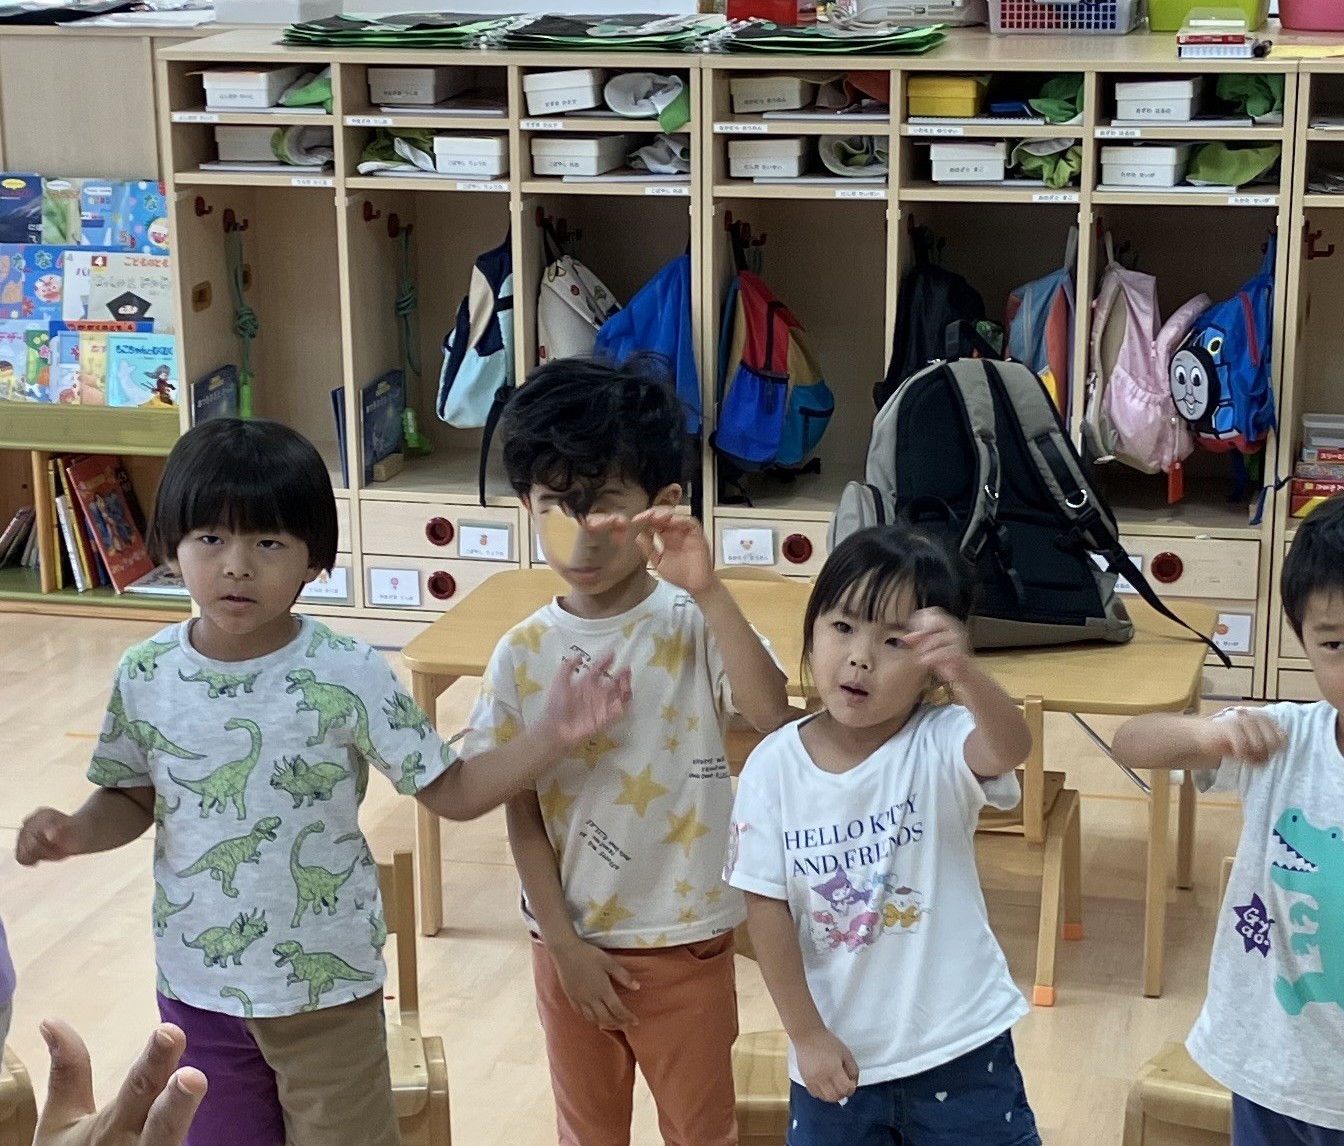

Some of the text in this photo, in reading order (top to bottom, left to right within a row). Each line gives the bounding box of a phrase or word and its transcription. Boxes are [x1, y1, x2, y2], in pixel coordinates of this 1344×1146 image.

[784, 793, 918, 850] HELLO KTY
[792, 854, 839, 878] AND
